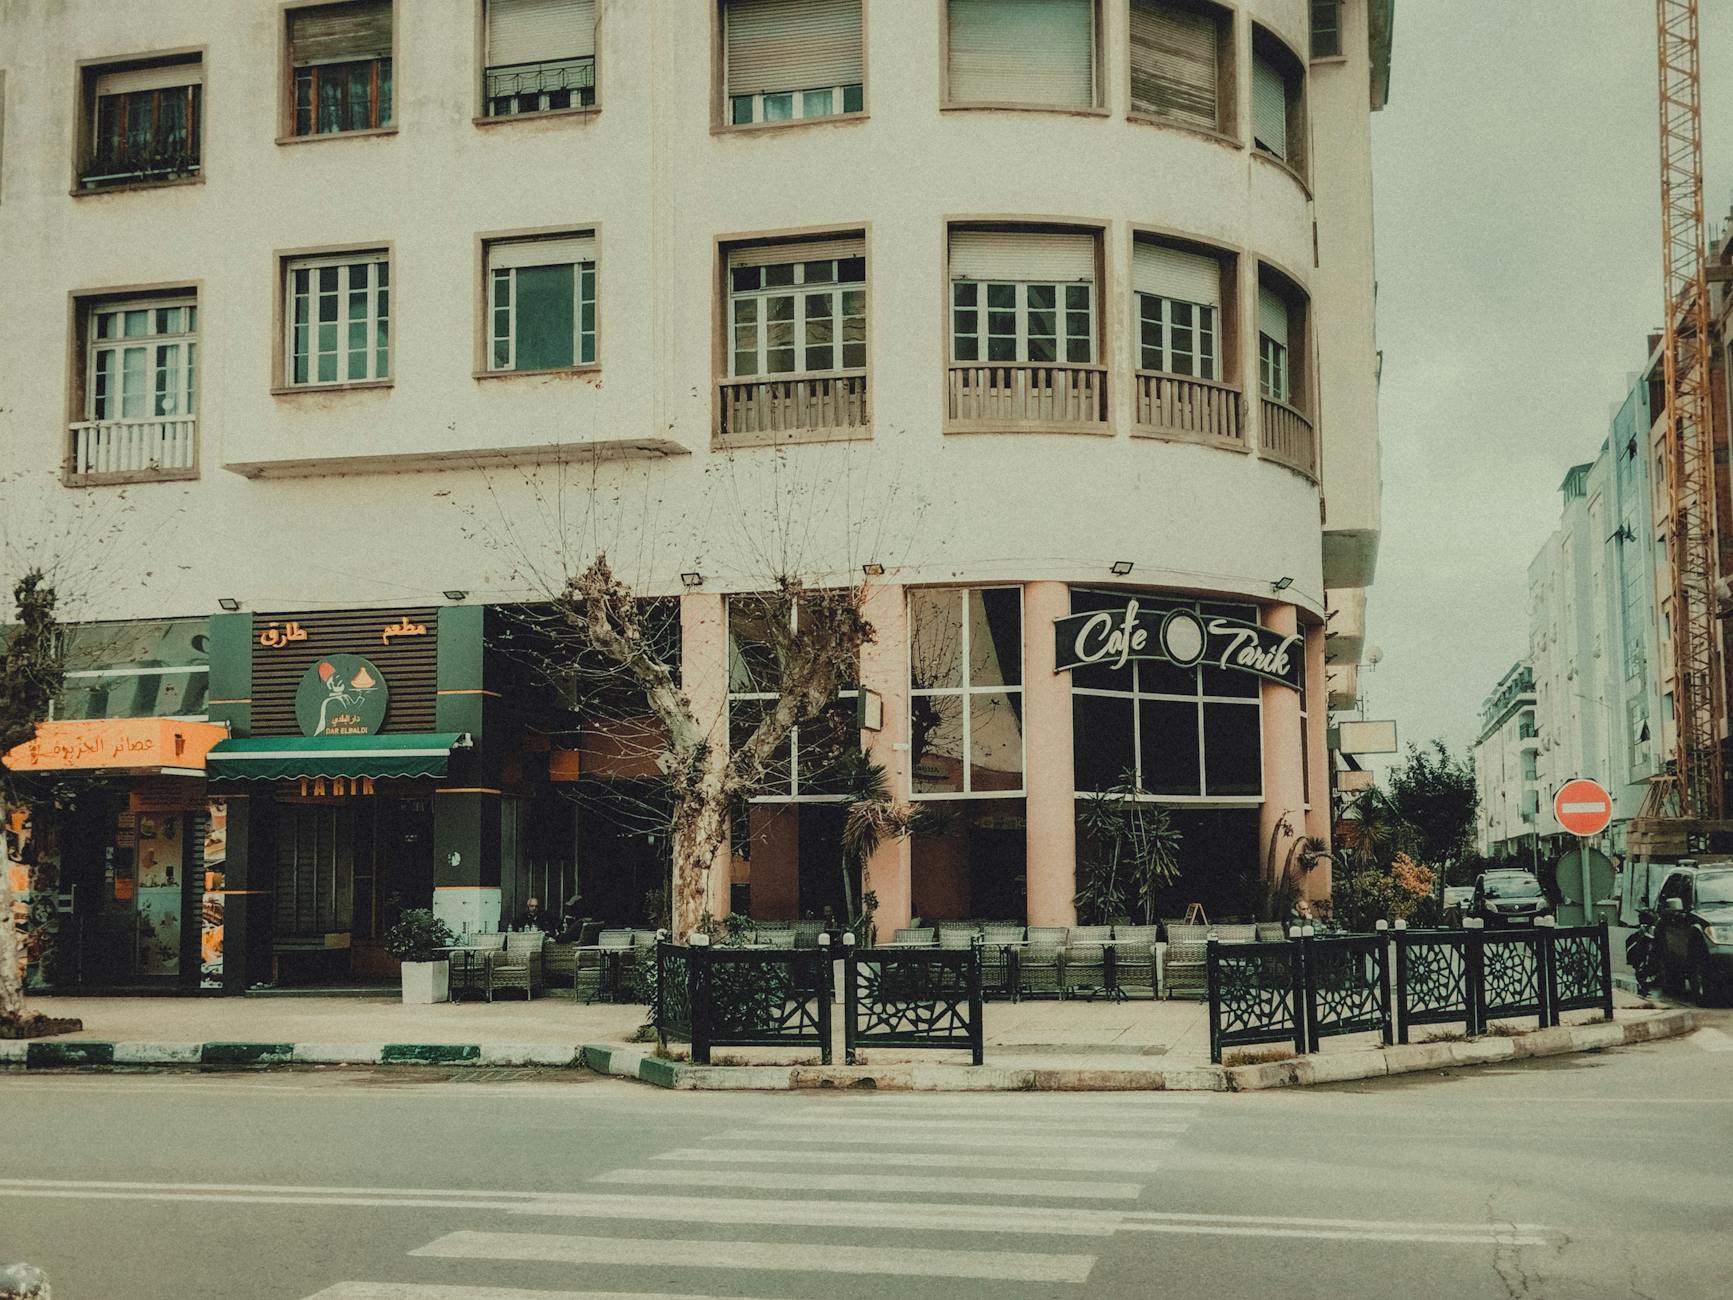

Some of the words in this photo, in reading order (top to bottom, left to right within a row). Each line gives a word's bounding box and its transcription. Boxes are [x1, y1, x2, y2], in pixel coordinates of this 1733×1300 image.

[260, 622, 307, 648] طارق
[383, 616, 427, 646] مطعم
[1075, 599, 1148, 670] Cafe
[1207, 619, 1303, 675] Tarik
[325, 727, 339, 735] DAR
[111, 735, 154, 759] عصائر
